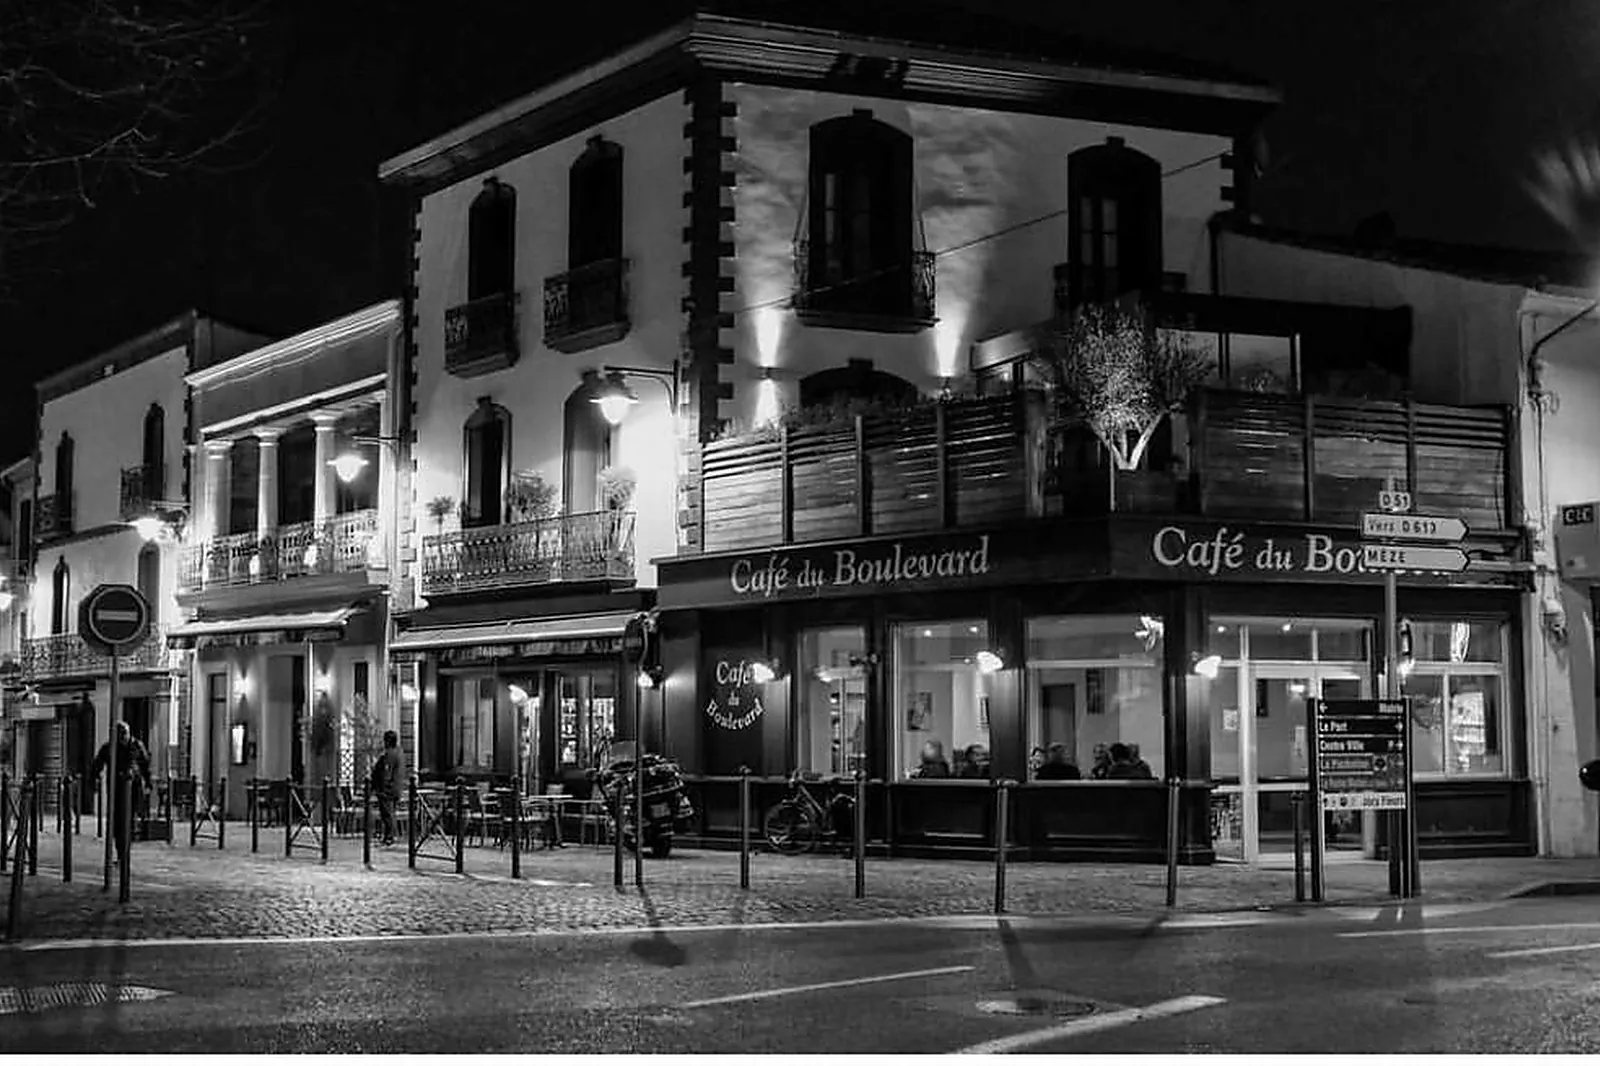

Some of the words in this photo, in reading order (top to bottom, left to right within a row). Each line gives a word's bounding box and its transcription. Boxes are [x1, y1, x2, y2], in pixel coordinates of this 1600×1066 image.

[731, 552, 789, 598] Café
[797, 559, 824, 588] du
[832, 534, 990, 587] Boulevard
[1152, 525, 1245, 575] Café
[1255, 539, 1293, 570] du
[706, 697, 764, 730] Boulevard
